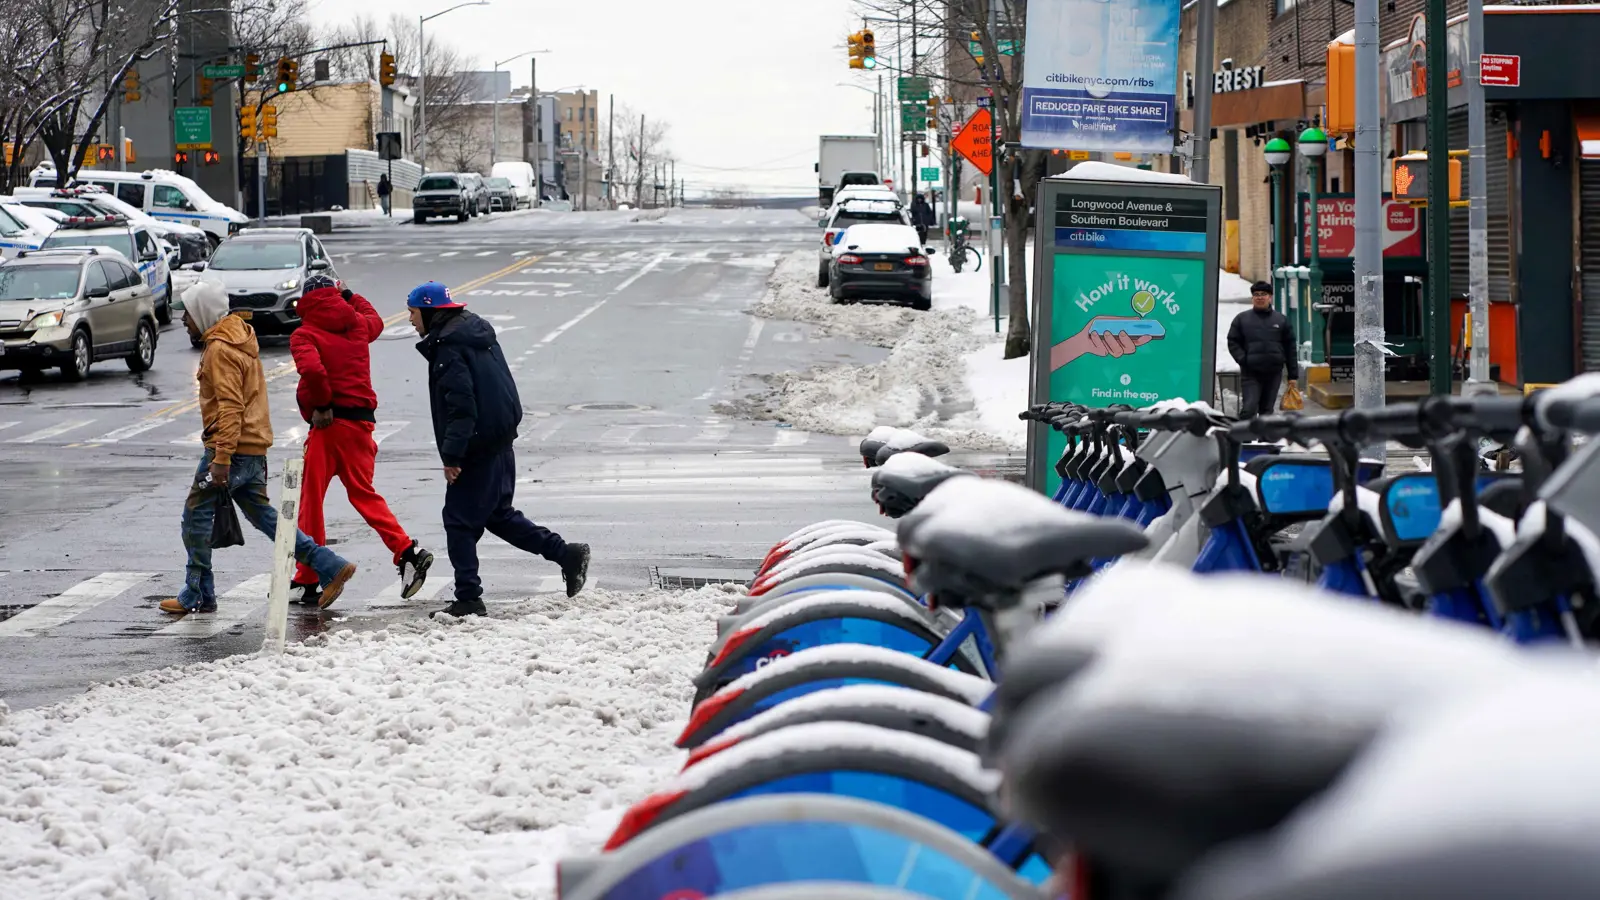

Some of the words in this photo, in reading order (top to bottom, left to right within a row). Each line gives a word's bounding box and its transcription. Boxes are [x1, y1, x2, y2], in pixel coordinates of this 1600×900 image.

[1490, 57, 1513, 65] STOPPING
[1482, 64, 1503, 72] Anytime
[1046, 74, 1154, 87] citibikenyc.com/rfbs
[1035, 101, 1081, 112] REDUCED
[1082, 104, 1106, 114] FARE
[1107, 106, 1129, 115] BIKE
[1130, 106, 1162, 116] SHARE
[972, 124, 991, 132] ROA
[1079, 121, 1116, 131] healthfirst
[973, 136, 992, 145] WOR
[1071, 198, 1124, 211] Longwood
[1126, 200, 1164, 212] Avenue
[1165, 202, 1173, 212] &
[1337, 201, 1356, 213] Yo
[1070, 214, 1117, 226] Southern
[1118, 216, 1169, 228] Boulevard
[1075, 281, 1114, 312] How
[1116, 273, 1130, 291] it
[1134, 279, 1180, 315] works
[1322, 294, 1344, 304] tion
[1091, 388, 1112, 398] Find
[1113, 388, 1122, 398] in
[1123, 390, 1139, 399] the
[1140, 391, 1159, 401] app
